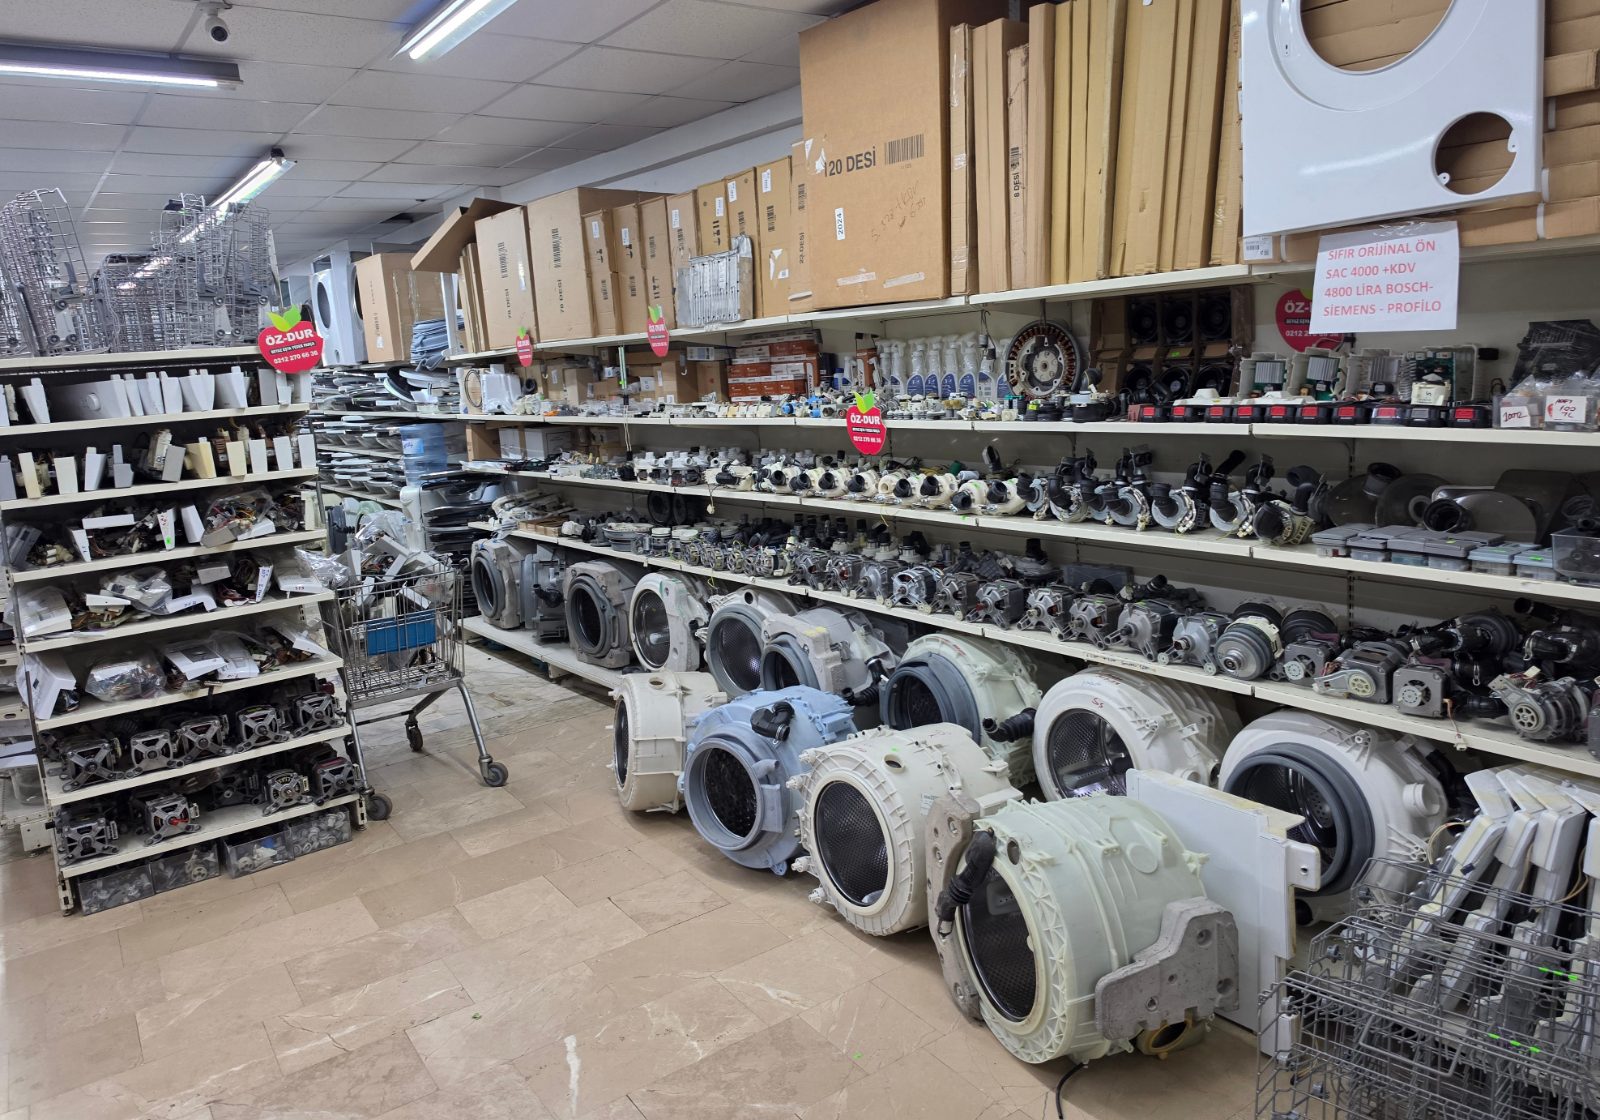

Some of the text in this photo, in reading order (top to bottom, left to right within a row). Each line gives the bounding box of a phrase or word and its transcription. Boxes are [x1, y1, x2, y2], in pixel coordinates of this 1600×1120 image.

[846, 146, 876, 172] DESİ
[836, 212, 844, 236] 2024
[1358, 242, 1412, 258] ORİJİNAL
[1416, 240, 1436, 252] ÖN
[1326, 262, 1416, 279] SAC 4000 +KDV
[1324, 281, 1434, 298] 4800 LİRA BOSCH-
[1324, 303, 1376, 316] SİEMENS
[1388, 299, 1441, 313] PROFİLO
[266, 329, 314, 346] ÖZ-DUR
[850, 413, 880, 424] ÖZ-DUR
